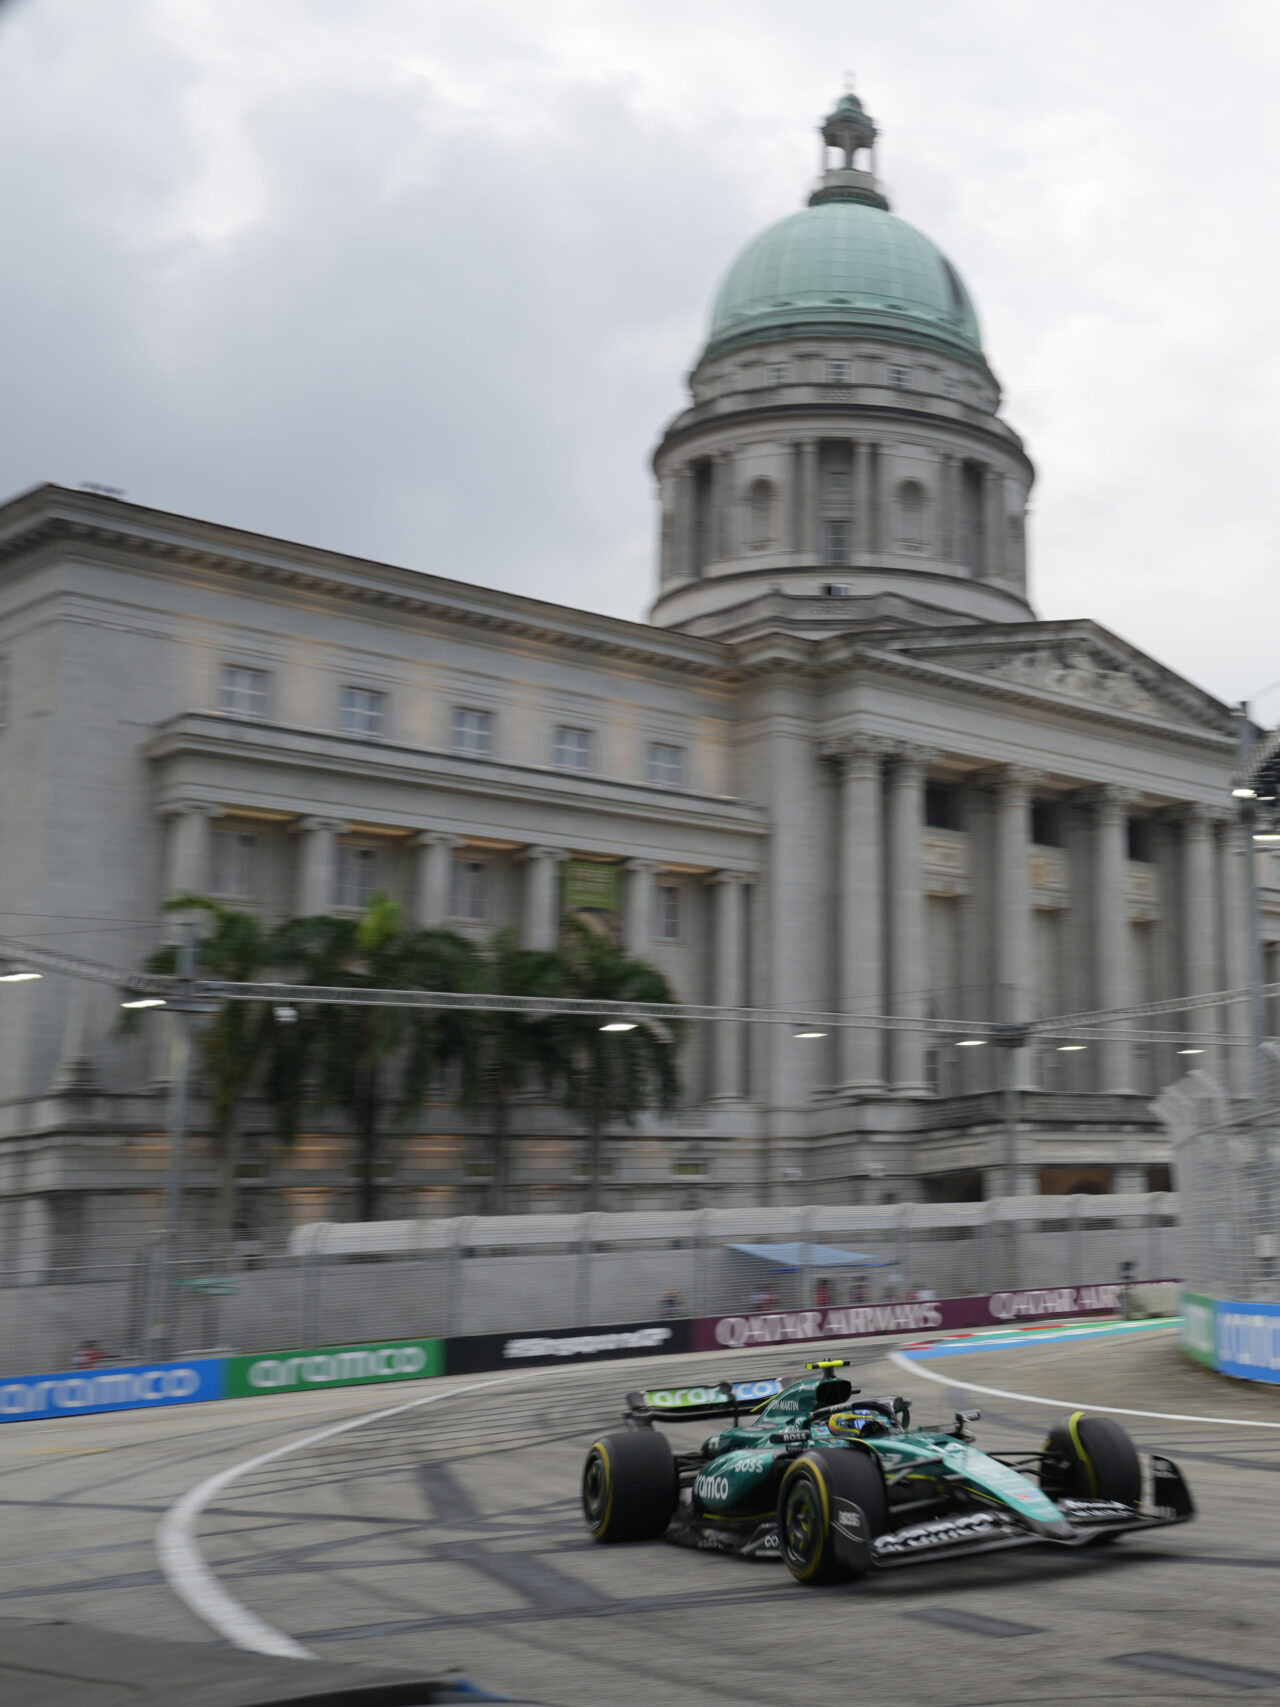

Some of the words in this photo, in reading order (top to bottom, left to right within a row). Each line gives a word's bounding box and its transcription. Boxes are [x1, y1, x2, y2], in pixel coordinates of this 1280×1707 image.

[989, 1289, 1079, 1319] QATAR
[1078, 1285, 1124, 1310] AIR
[715, 1311, 823, 1348] QATAR
[823, 1302, 943, 1336] AIRWAYS
[248, 1346, 427, 1387] aramco
[0, 1369, 199, 1414] aramco
[783, 1432, 807, 1442] BOSS
[735, 1458, 764, 1473] BOSS
[695, 1474, 729, 1500] ramco
